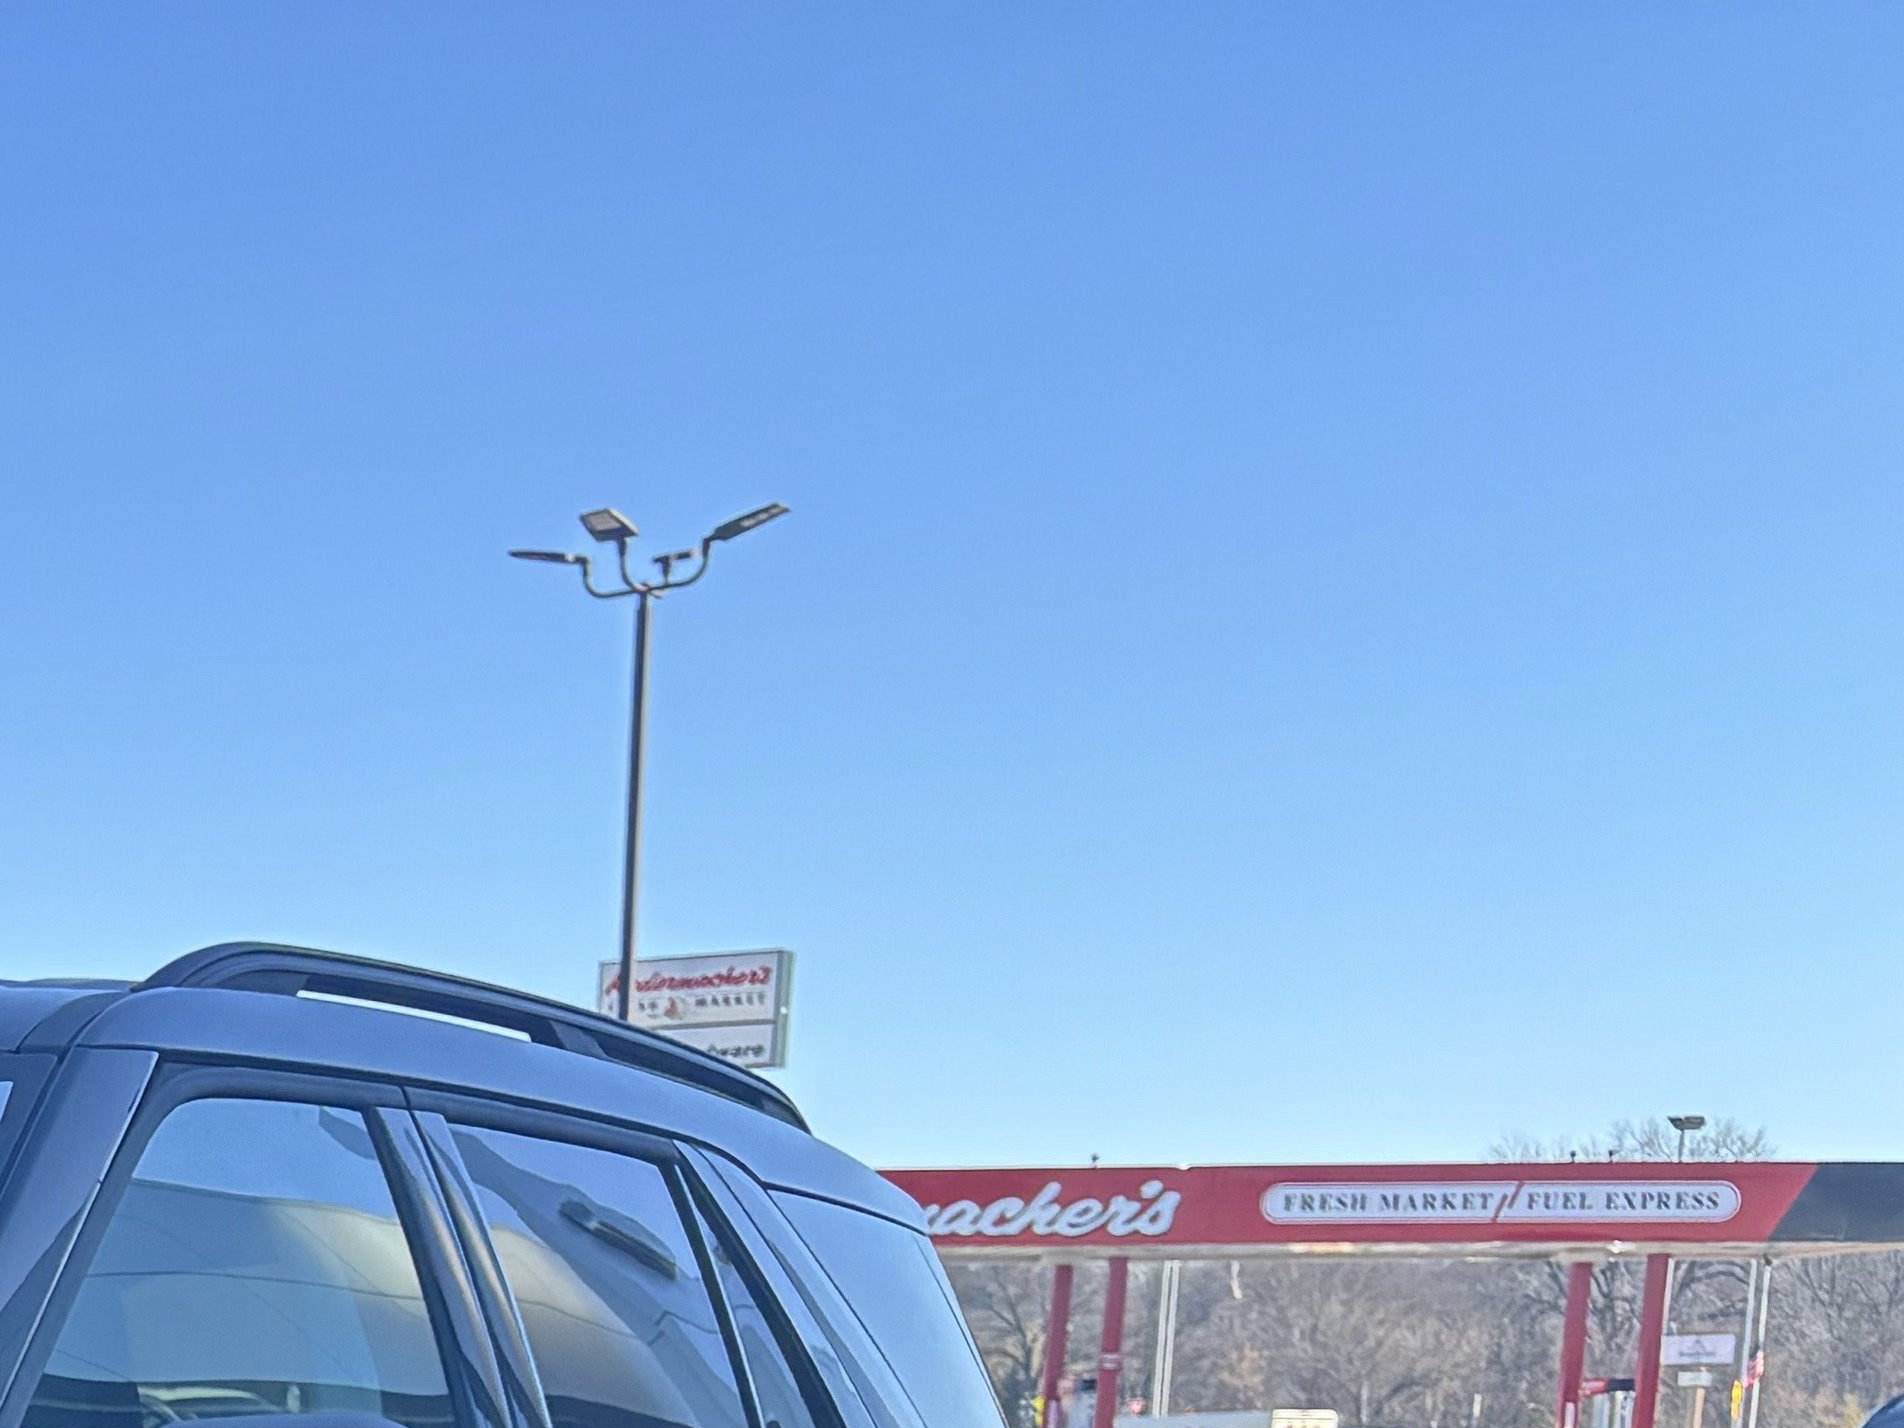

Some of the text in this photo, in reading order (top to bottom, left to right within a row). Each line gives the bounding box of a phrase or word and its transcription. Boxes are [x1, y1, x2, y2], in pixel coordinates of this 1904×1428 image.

[926, 1180, 1182, 1237] acher's
[1283, 1191, 1720, 1213] FRESH MARKET FUEL EXPRESS
